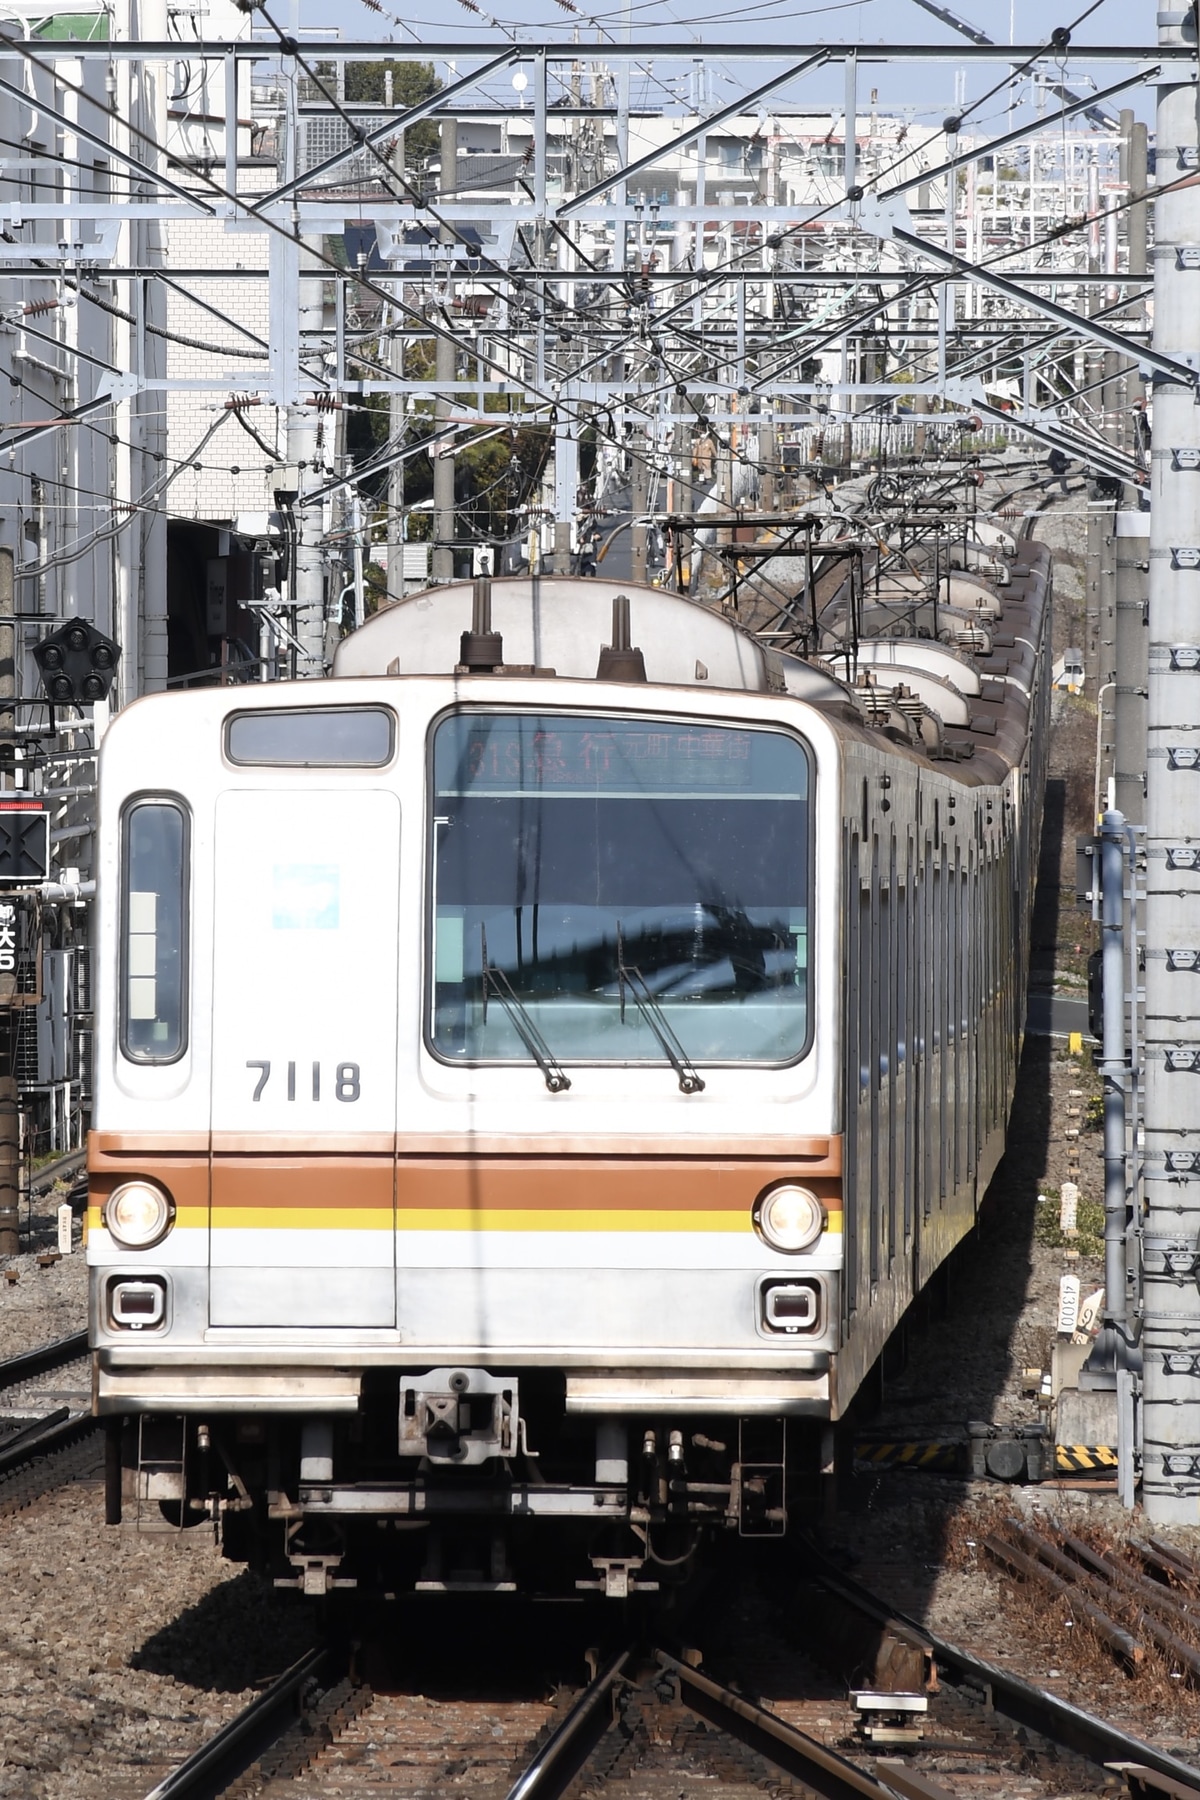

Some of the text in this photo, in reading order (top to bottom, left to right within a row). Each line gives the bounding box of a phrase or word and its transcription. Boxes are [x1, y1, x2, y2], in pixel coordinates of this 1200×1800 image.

[526, 731, 618, 770] 急行
[246, 1060, 361, 1102] 7118
[1061, 1285, 1077, 1327] 4300
